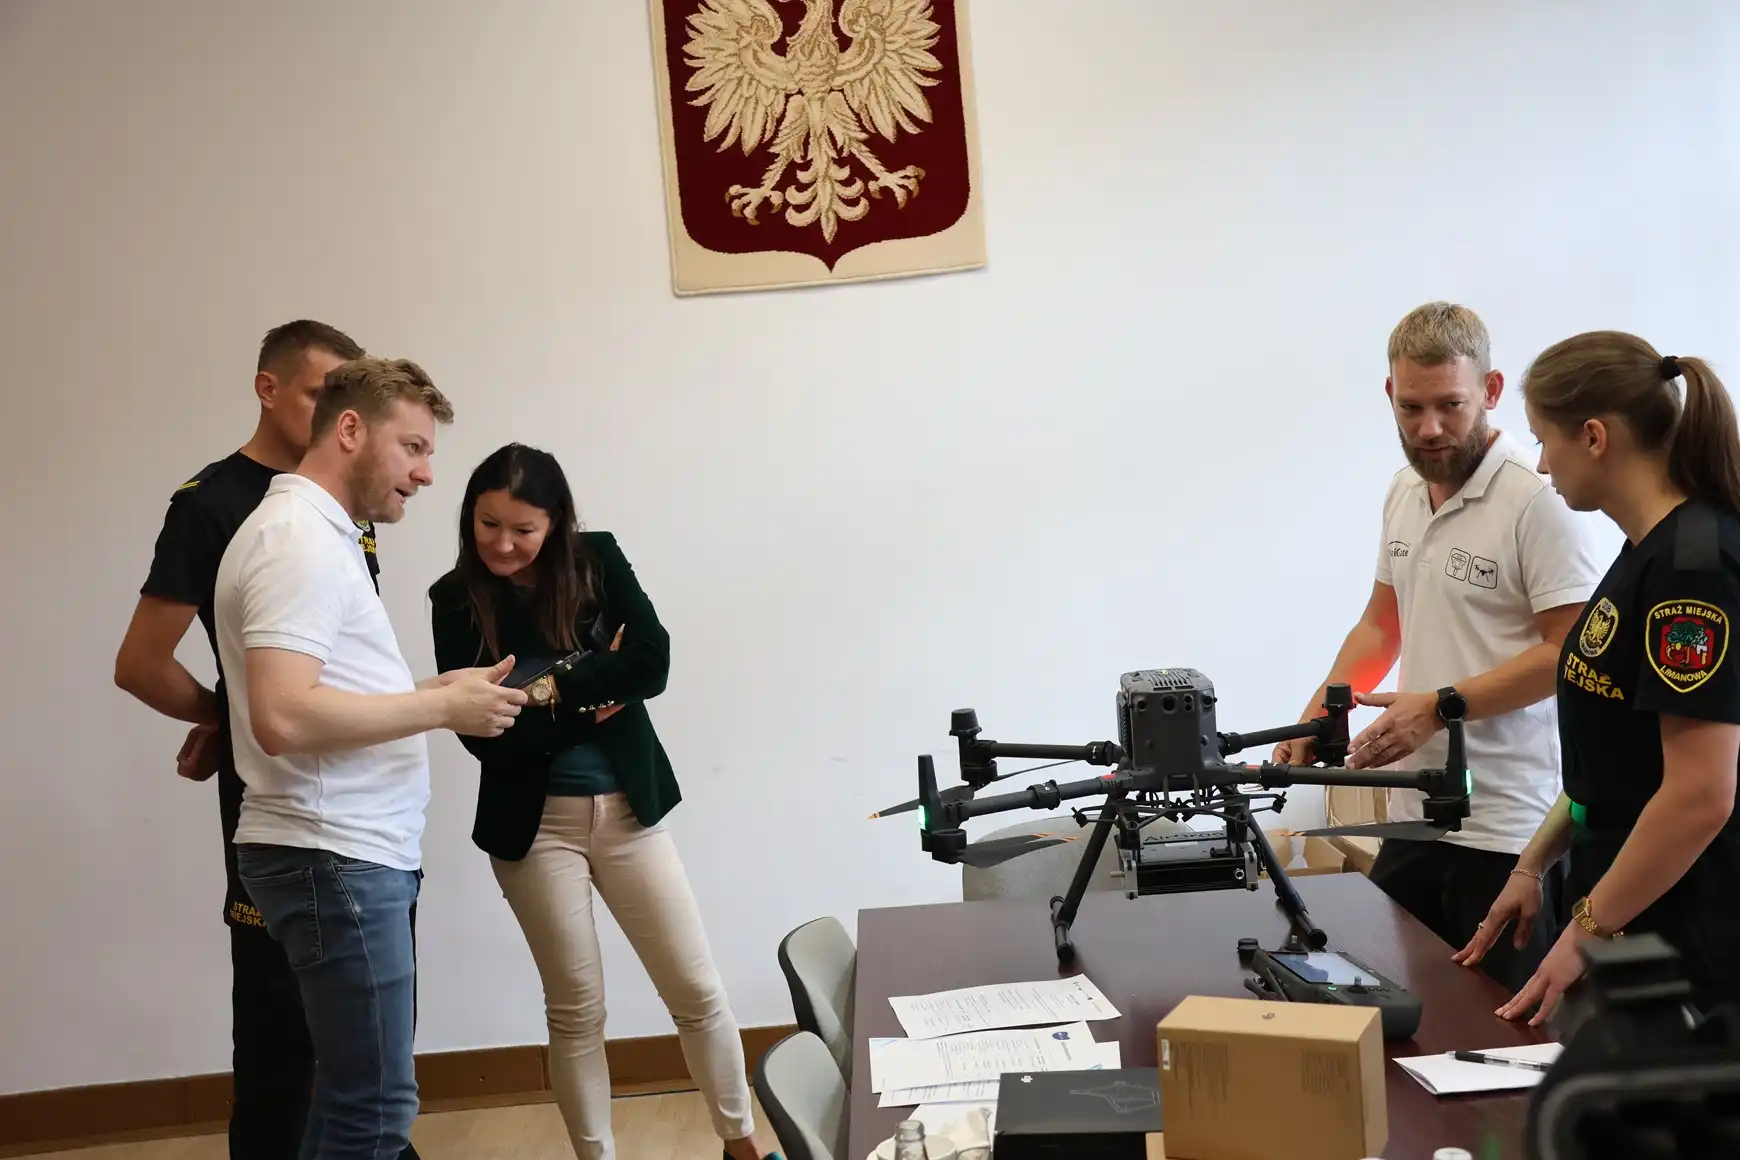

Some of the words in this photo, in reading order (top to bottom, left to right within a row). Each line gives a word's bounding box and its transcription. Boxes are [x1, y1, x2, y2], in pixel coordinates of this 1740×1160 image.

[1654, 604, 1683, 620] STRAŻ
[1685, 606, 1723, 625] MIEJSKA
[1660, 664, 1708, 682] LIMANOWA
